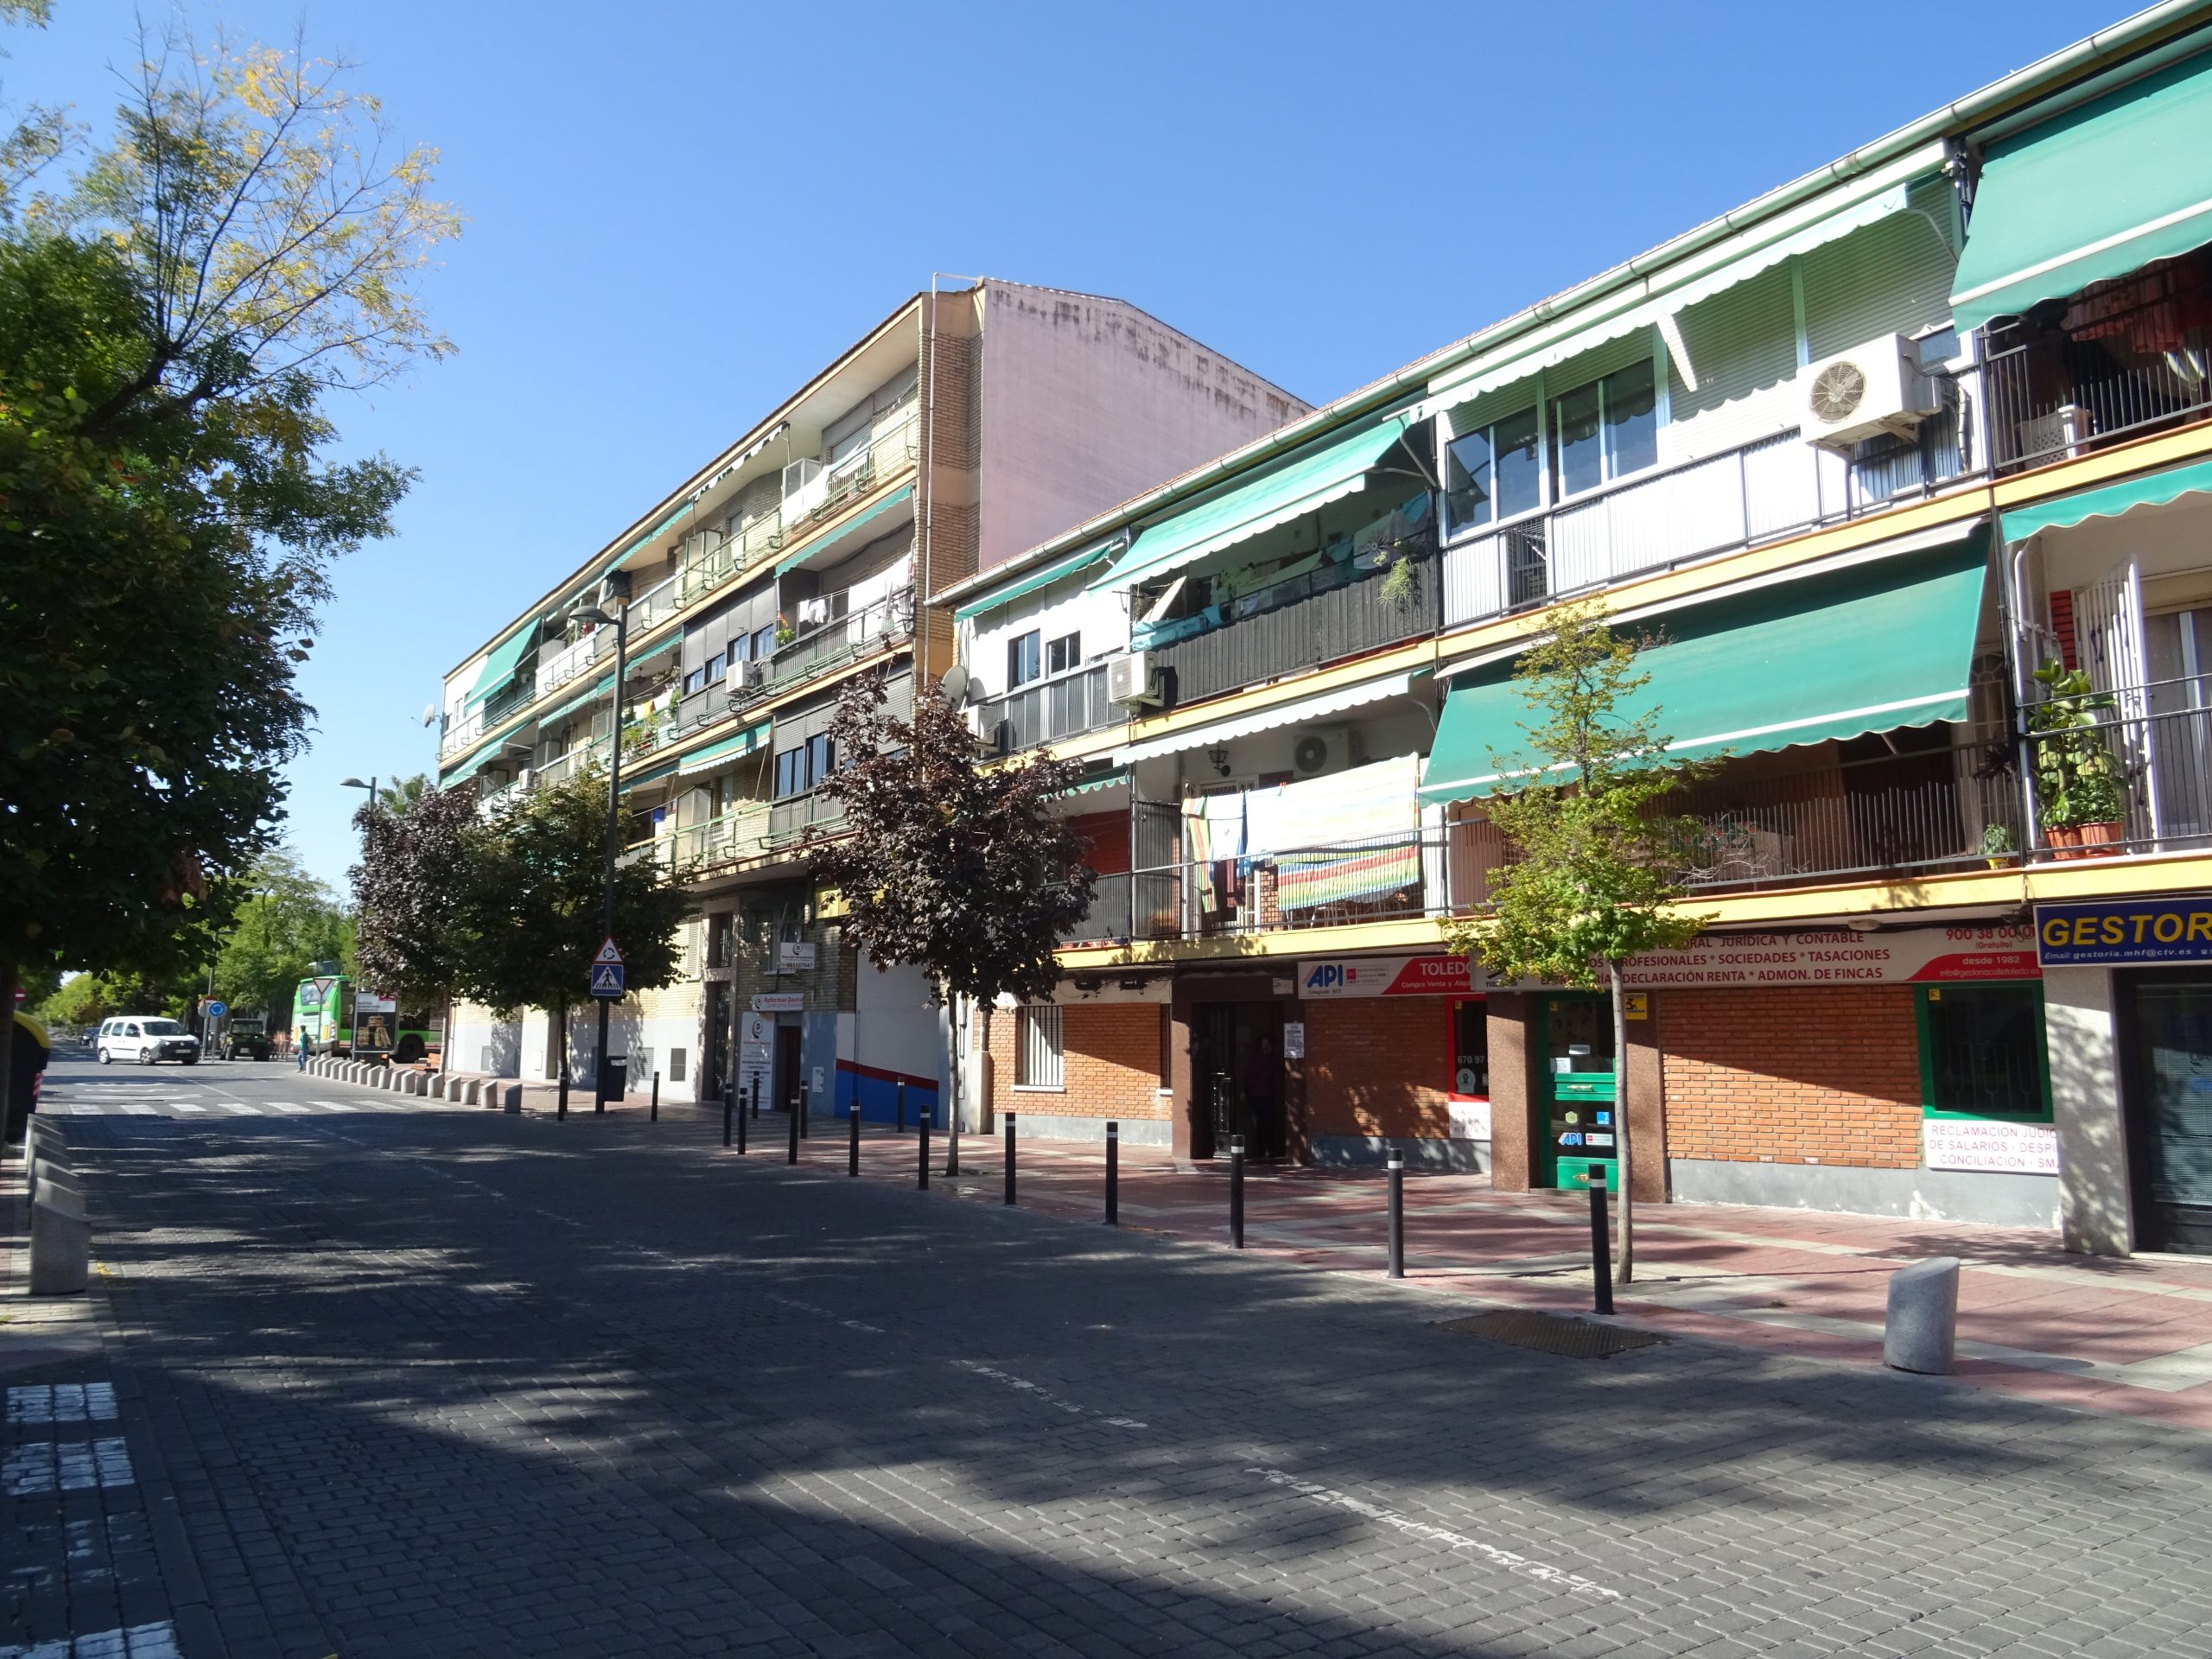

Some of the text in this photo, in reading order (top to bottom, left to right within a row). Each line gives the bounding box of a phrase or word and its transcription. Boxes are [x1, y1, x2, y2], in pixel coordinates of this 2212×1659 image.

[1946, 927, 1973, 940] 900
[1977, 926, 1993, 939] 38
[1658, 931, 1864, 950] LORAL JURÍDICA Y CONTABLE
[1975, 940, 2013, 950] (Gratuito)
[1617, 956, 1707, 968] ROFESIONALES
[1718, 951, 1796, 964] SOCIEDADES
[1808, 948, 1891, 962] TASACIONES
[1962, 956, 2020, 965] desde 1982
[2073, 949, 2192, 961] gestoria.mhf@ctv.es
[1305, 963, 1344, 988] API
[1622, 970, 1704, 983] DECLARACIÓN
[1707, 970, 1746, 982] RENTA
[1758, 969, 1811, 981] ADMON.
[1814, 969, 1831, 980] DE
[1834, 967, 1883, 979] FINCAS
[1931, 1125, 2018, 1138] RECLAMACION
[1560, 1133, 1582, 1146] API
[1929, 1140, 1944, 1150] DE
[1948, 1141, 2008, 1152] SALARIOS
[1940, 1154, 2025, 1166] CONCILIACION
